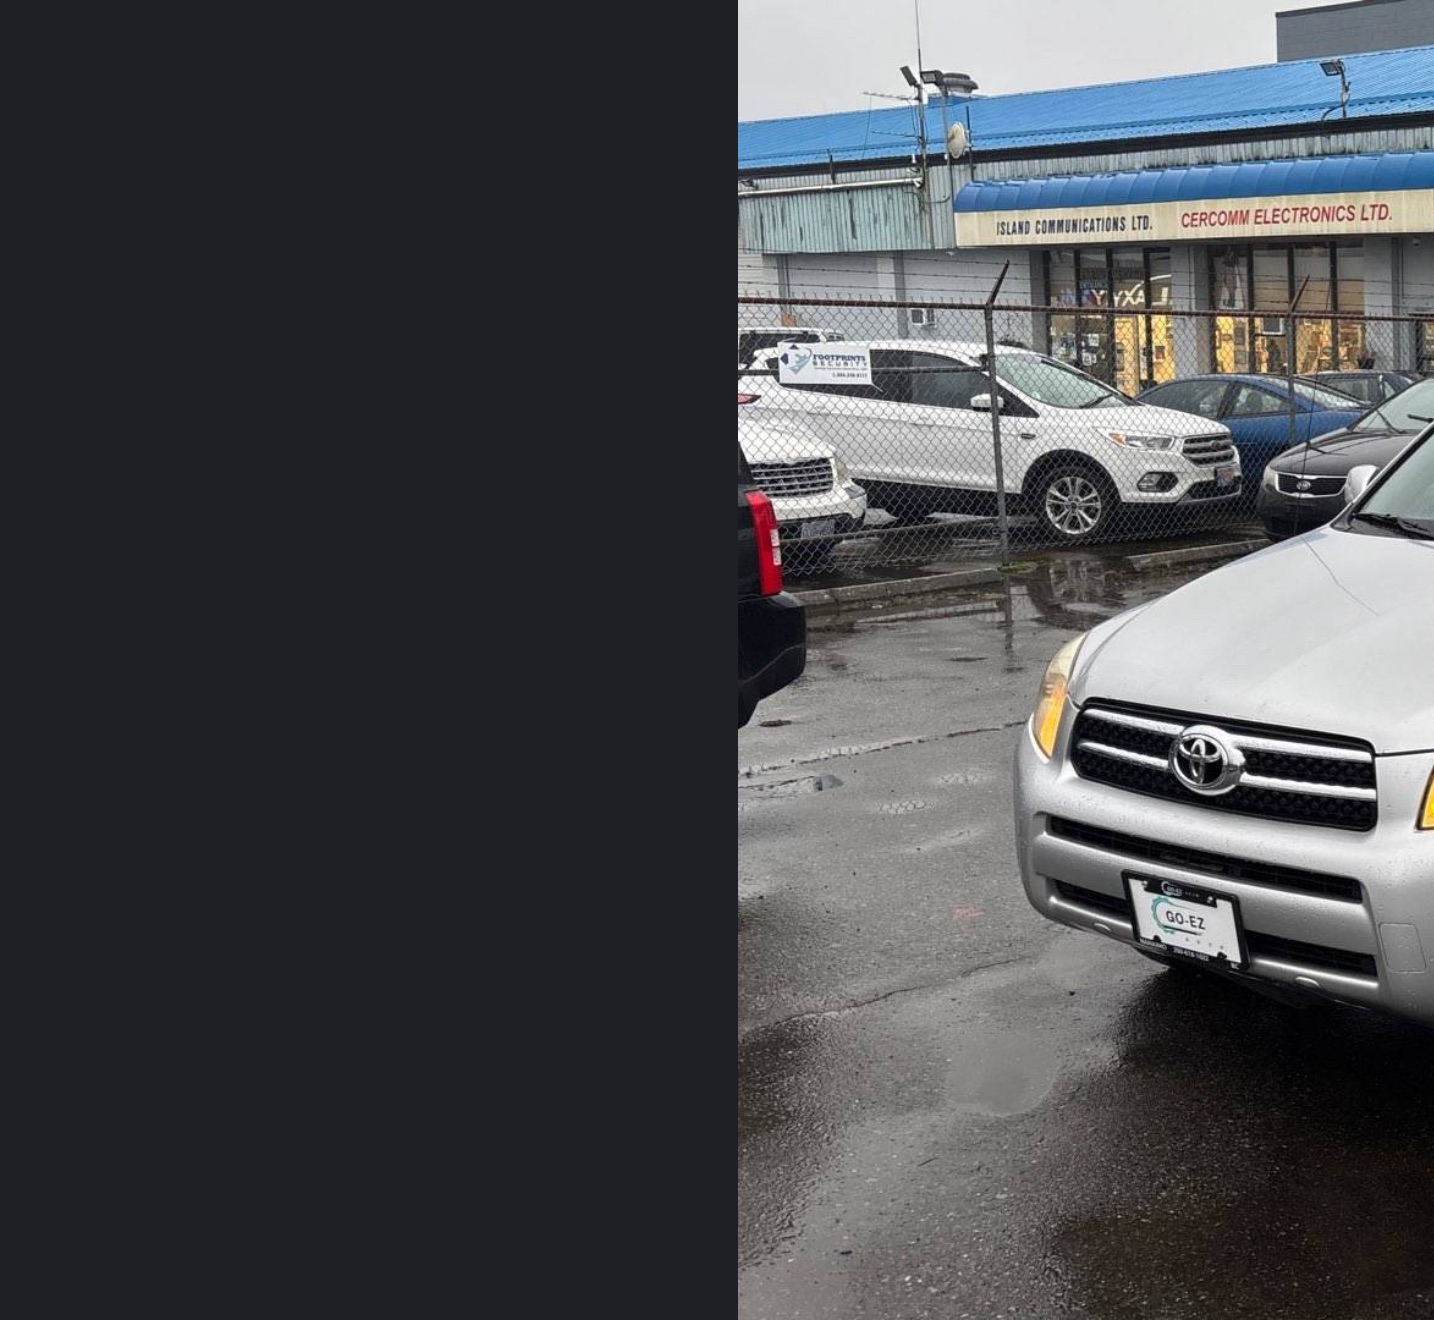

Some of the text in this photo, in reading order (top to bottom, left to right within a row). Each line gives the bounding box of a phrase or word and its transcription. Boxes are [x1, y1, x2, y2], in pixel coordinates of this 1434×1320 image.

[996, 214, 1153, 236] ISLAND COMMUNICATIONS LTD.
[1181, 202, 1393, 228] CERCOMM ELECTRONICS LTD.
[813, 354, 866, 362] FOOTPRINTS
[1166, 910, 1206, 930] GO-EZ
